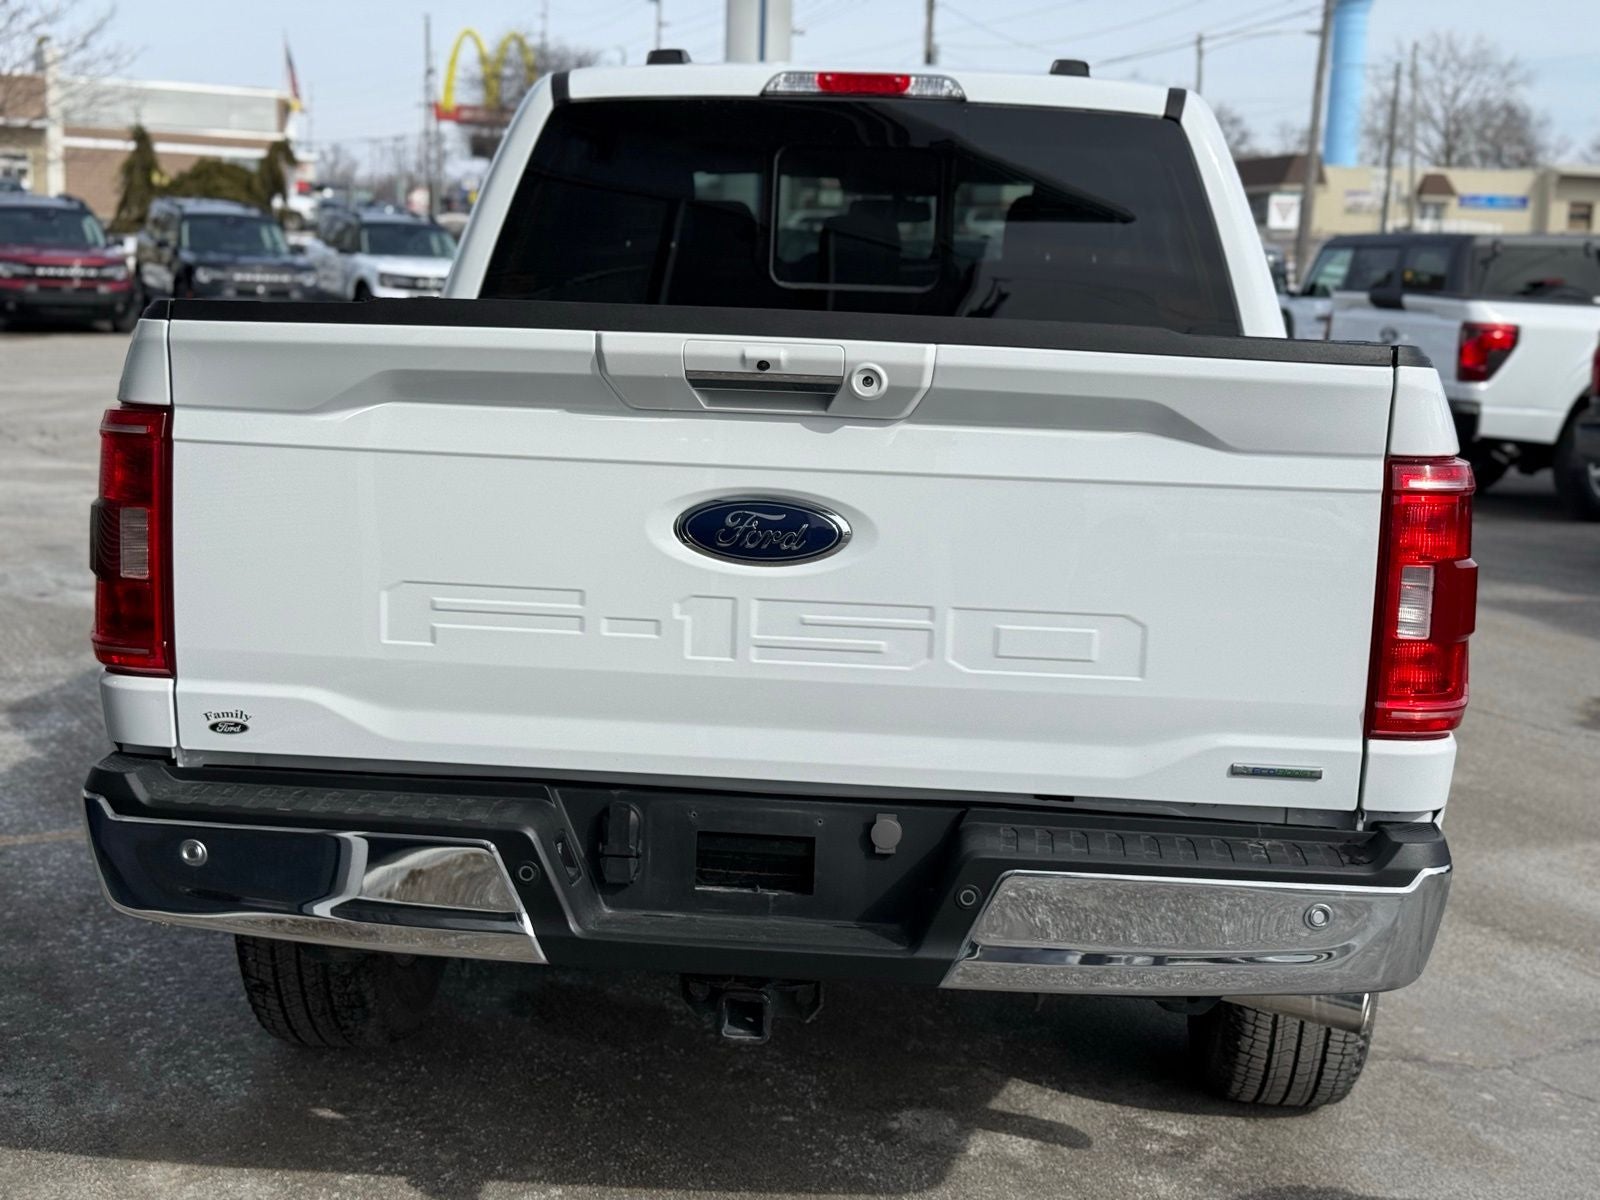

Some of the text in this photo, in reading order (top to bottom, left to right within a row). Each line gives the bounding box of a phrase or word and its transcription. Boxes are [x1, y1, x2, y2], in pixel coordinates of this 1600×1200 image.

[715, 510, 809, 551] Ford
[381, 580, 1148, 681] F-150
[203, 709, 252, 722] Family
[216, 722, 242, 732] Ford
